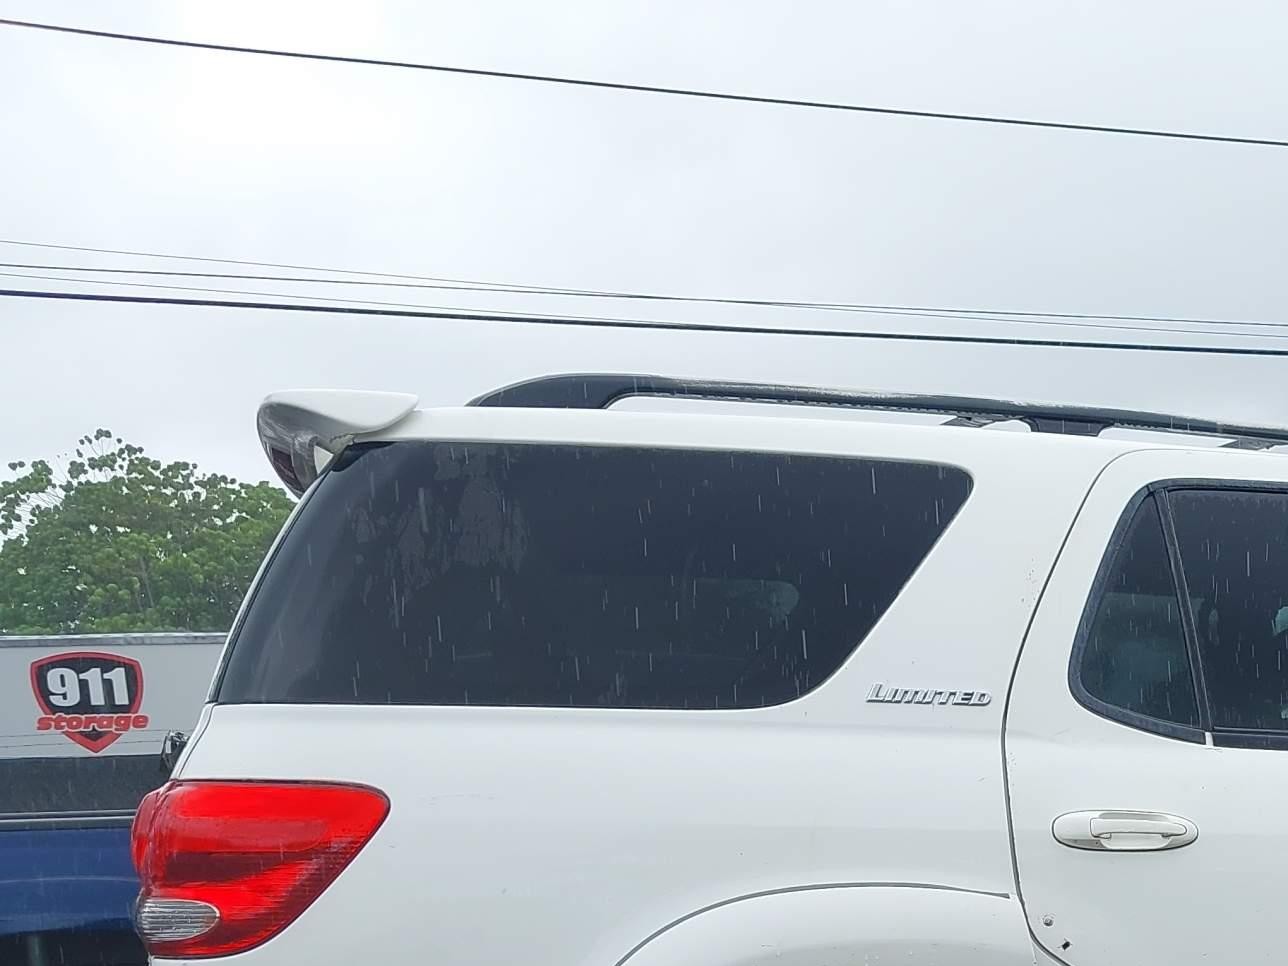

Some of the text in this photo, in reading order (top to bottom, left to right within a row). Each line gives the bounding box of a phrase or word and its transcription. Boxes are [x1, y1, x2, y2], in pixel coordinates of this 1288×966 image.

[46, 667, 130, 707] 911
[866, 683, 992, 706] LIMITED
[36, 714, 149, 732] storage
